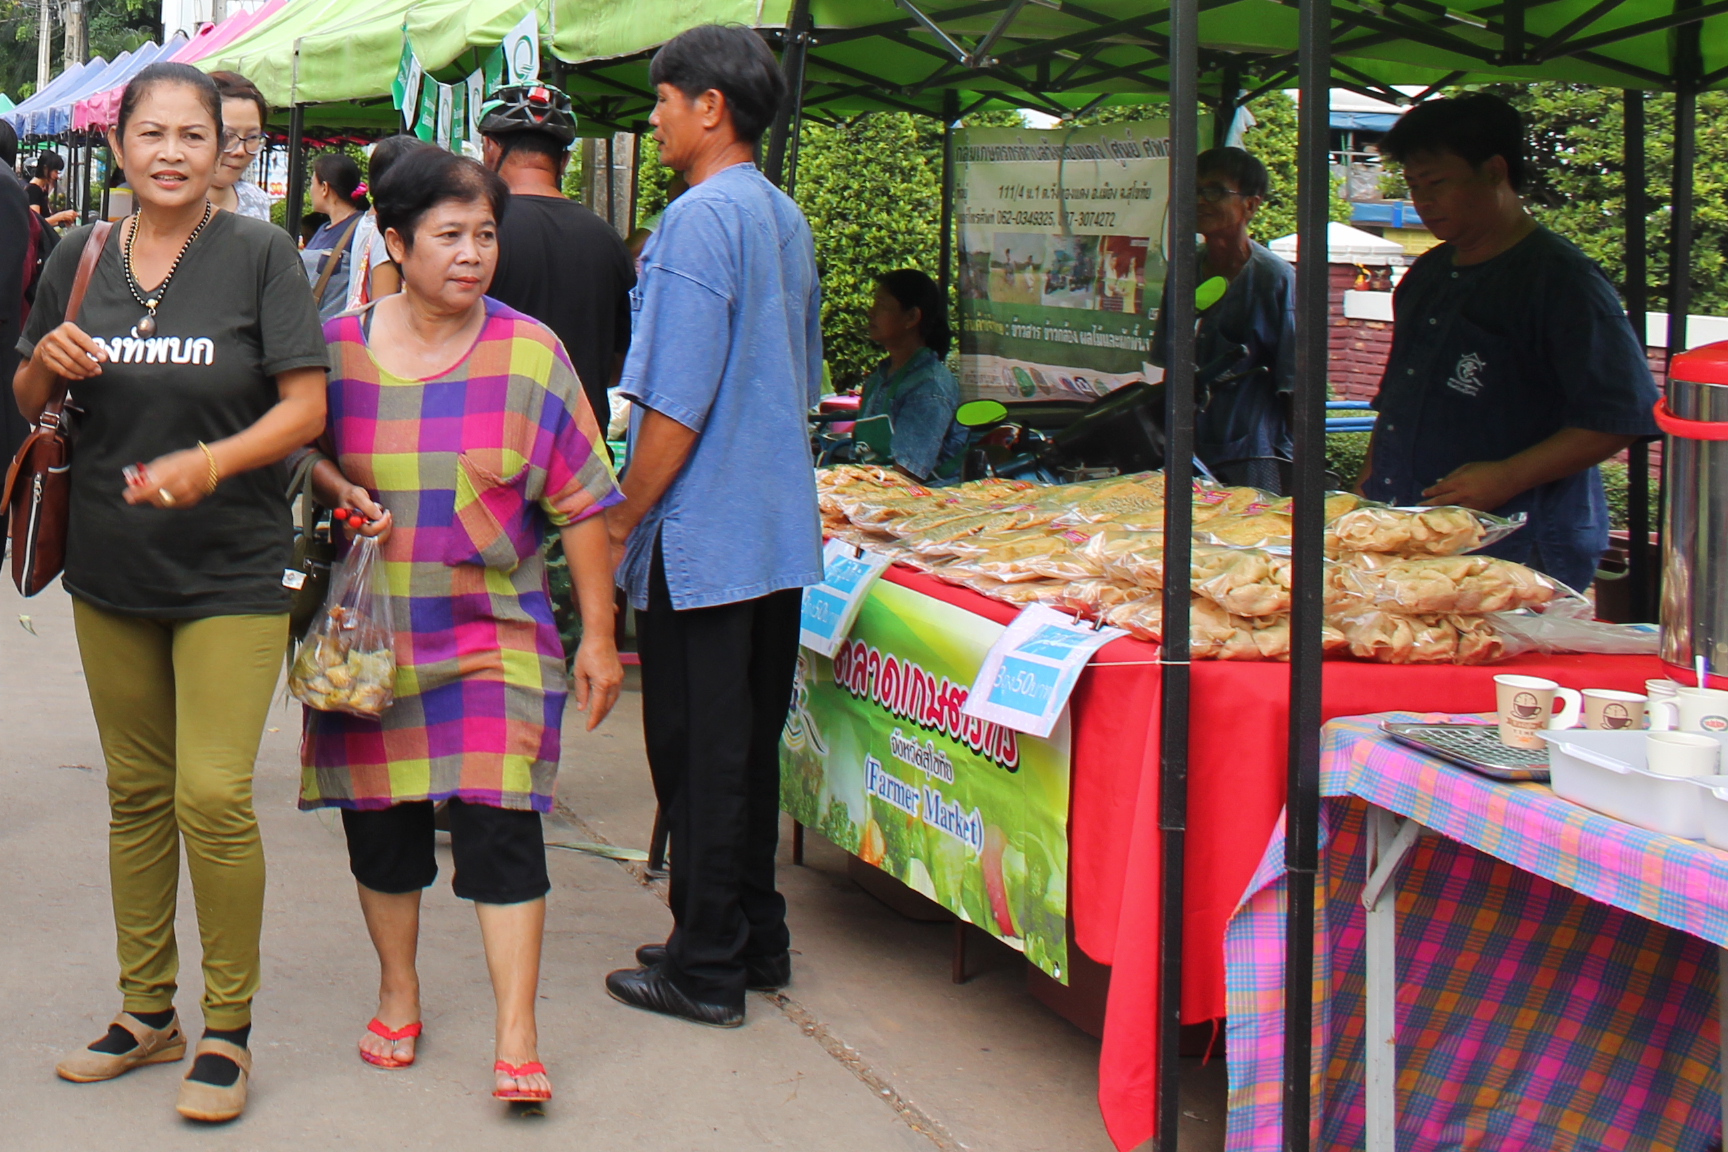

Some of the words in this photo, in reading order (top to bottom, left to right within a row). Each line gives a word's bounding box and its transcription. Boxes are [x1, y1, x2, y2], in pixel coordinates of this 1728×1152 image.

[998, 184, 1024, 202] 111/4
[1058, 212, 1115, 228] 7-3074272
[87, 326, 214, 365] งทัพบก
[864, 754, 920, 816] (Farmer
[923, 786, 983, 855] Market)
